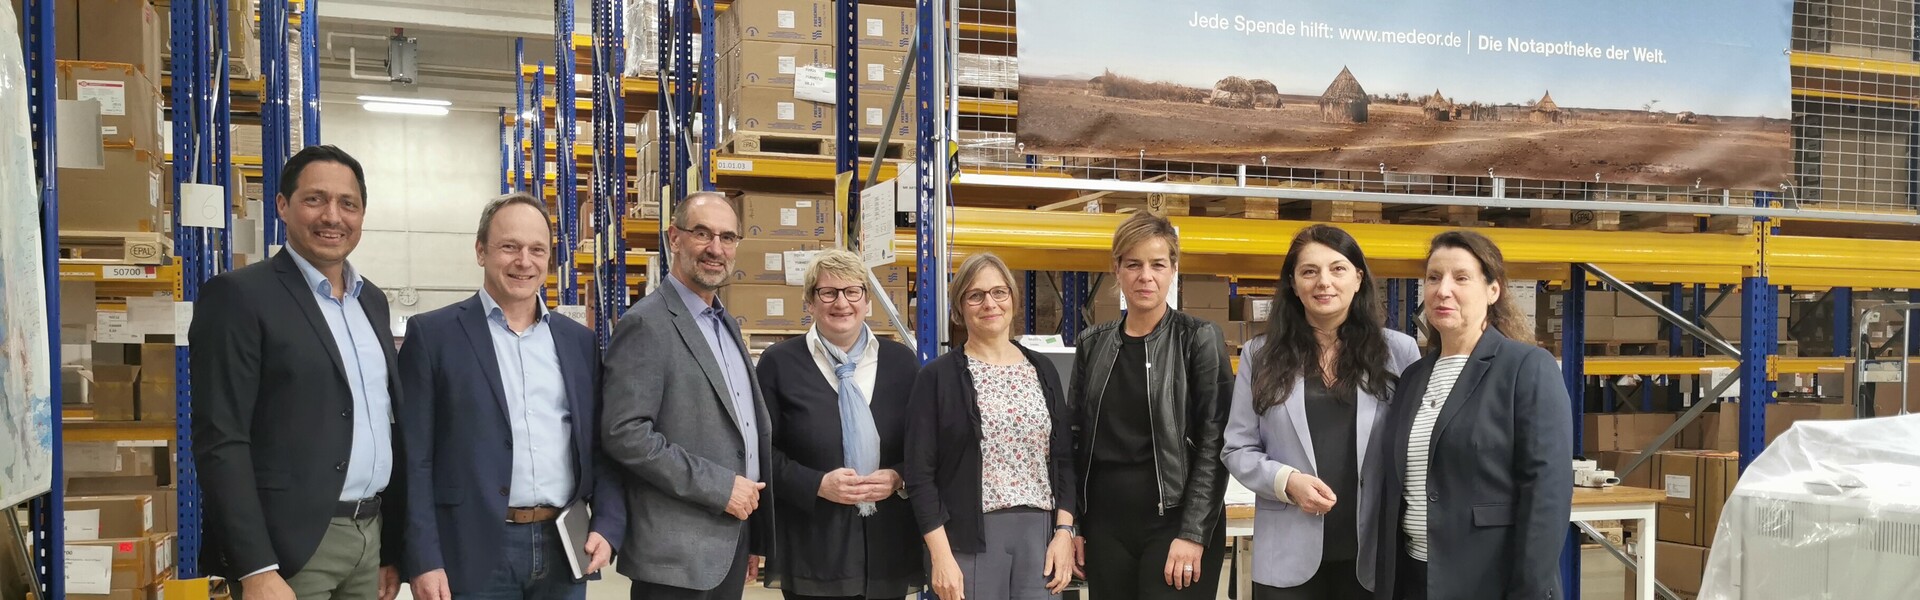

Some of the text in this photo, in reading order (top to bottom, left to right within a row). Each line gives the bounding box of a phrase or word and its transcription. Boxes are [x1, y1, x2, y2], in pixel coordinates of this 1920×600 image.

[1188, 11, 1667, 64] Jede Spende hilft: www.medeor.de Die Notapotheke der Welt.
[718, 162, 746, 170] 01.01.03
[202, 193, 217, 220] 6
[132, 246, 152, 256] EPAL
[113, 268, 141, 277] 50700
